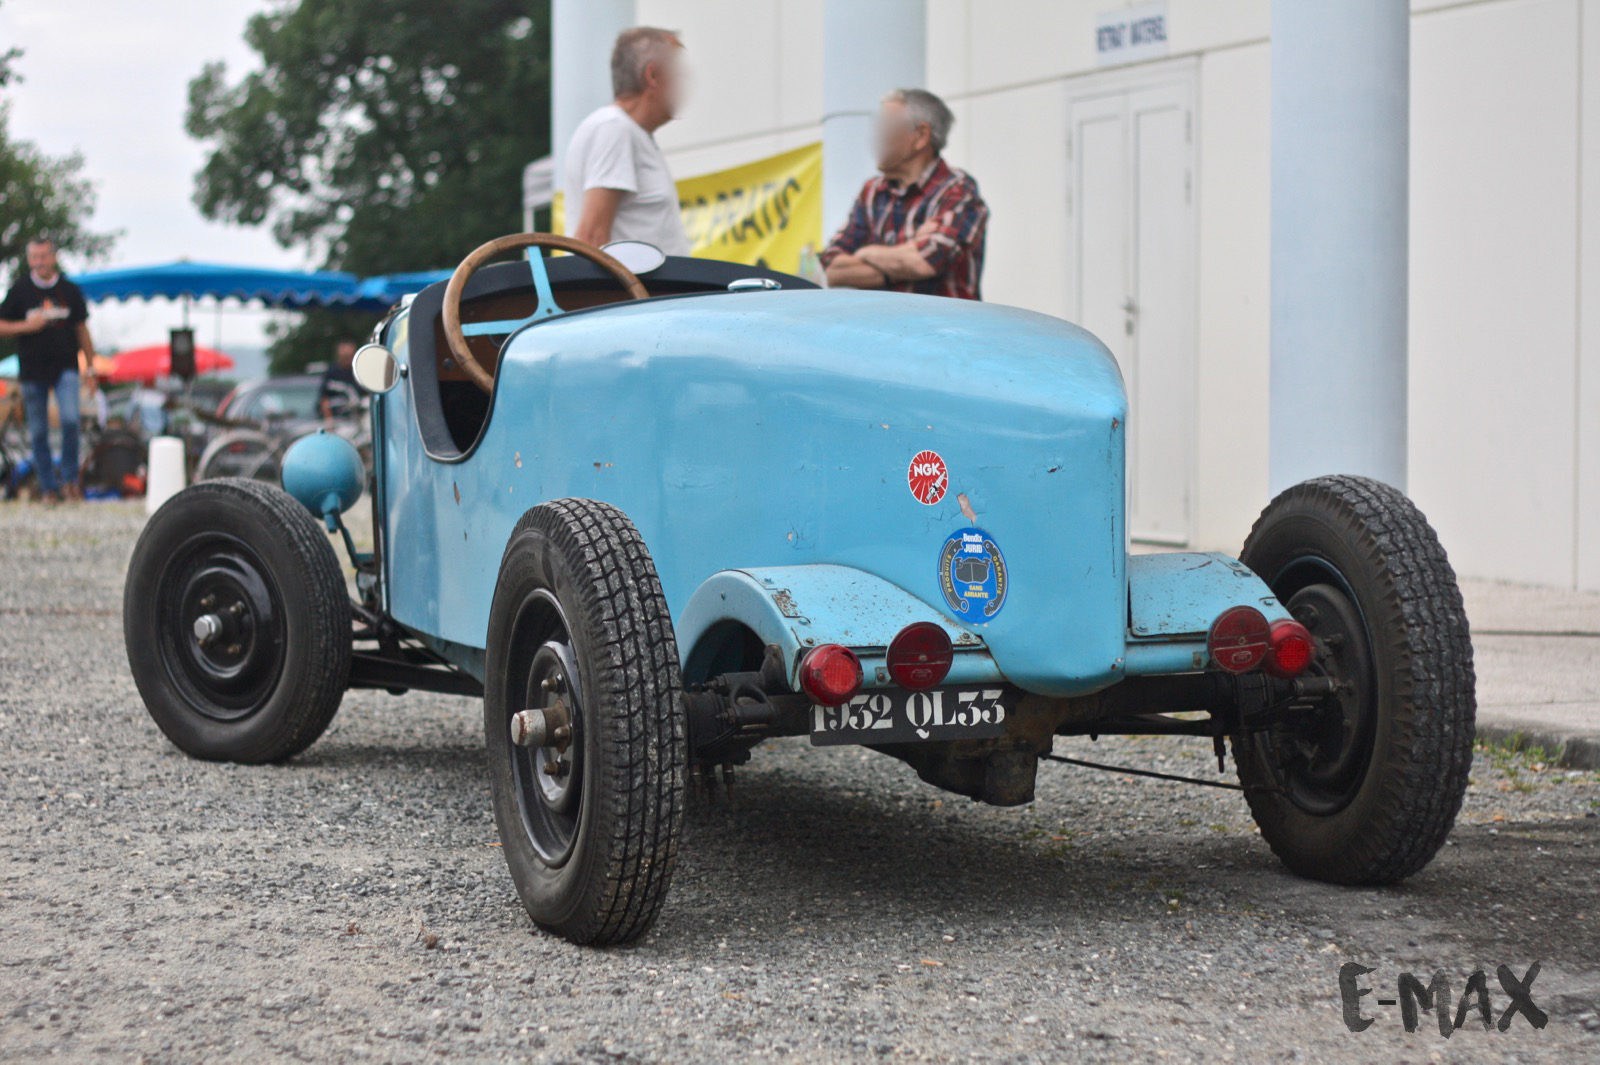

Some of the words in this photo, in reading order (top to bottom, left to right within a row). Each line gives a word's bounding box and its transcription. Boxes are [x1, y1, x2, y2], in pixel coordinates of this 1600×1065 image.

[913, 462, 941, 477] NGK
[963, 533, 983, 542] Bendix
[964, 544, 983, 554] JURID
[944, 554, 953, 593] PRODUITS
[964, 591, 989, 599] AMIANTE
[906, 689, 1005, 739] QL33
